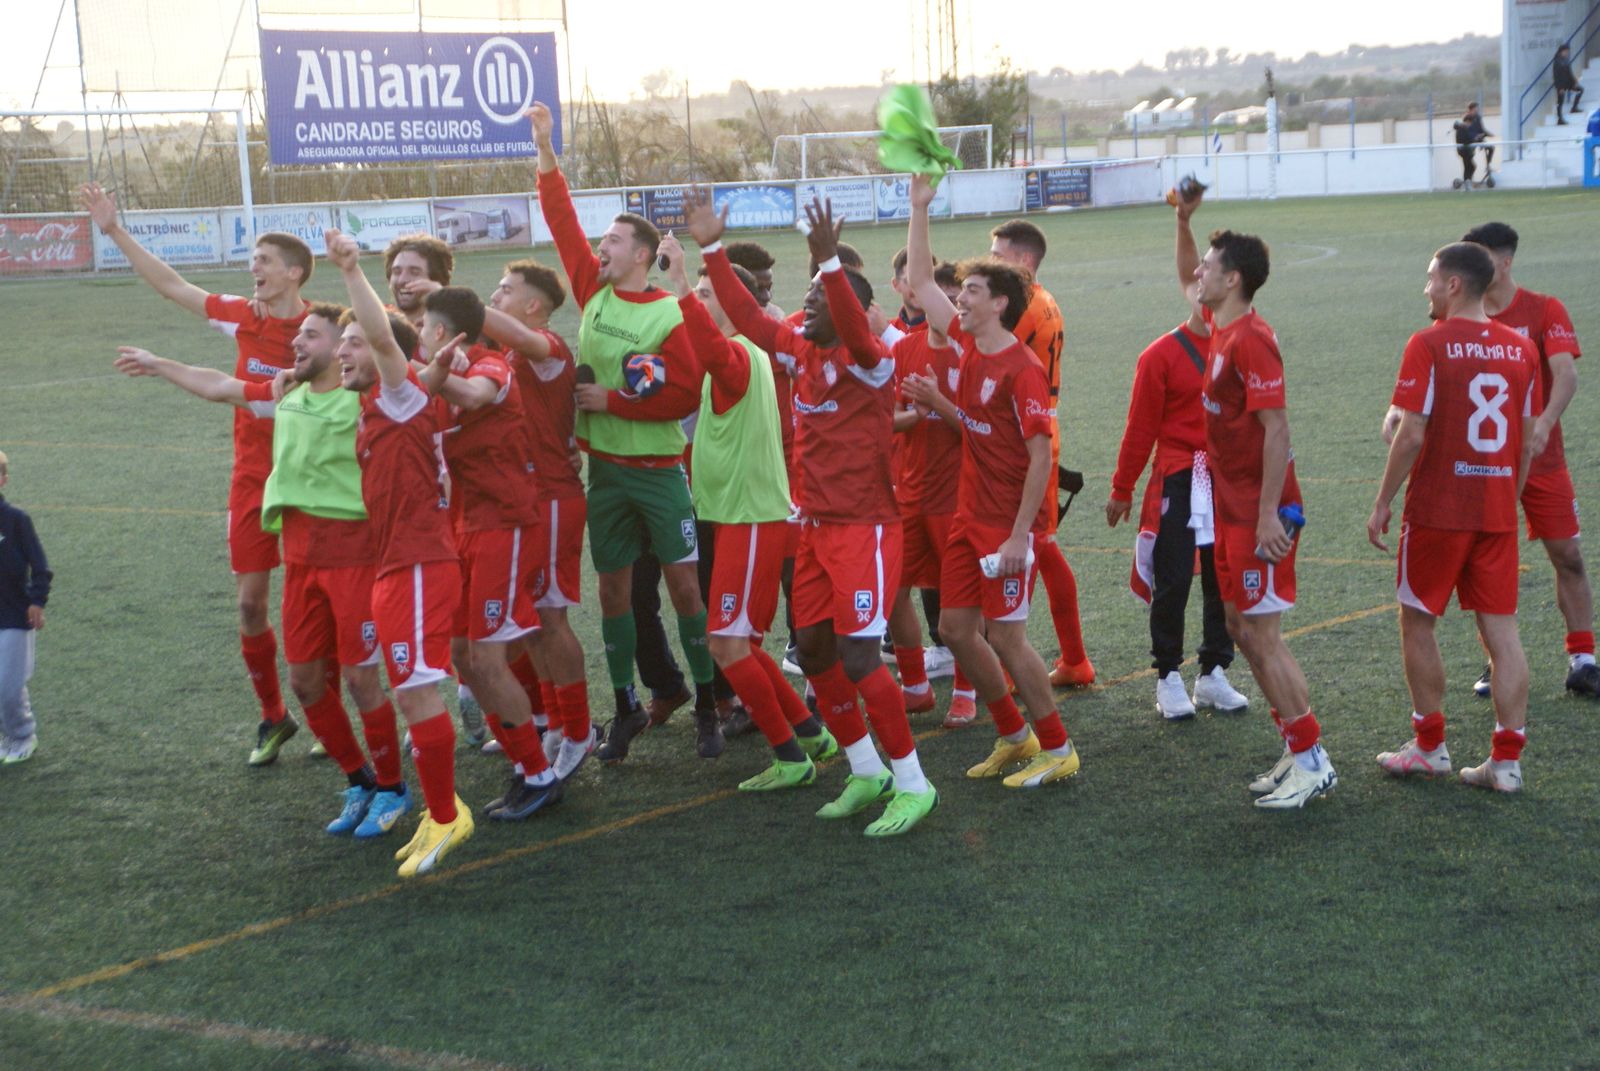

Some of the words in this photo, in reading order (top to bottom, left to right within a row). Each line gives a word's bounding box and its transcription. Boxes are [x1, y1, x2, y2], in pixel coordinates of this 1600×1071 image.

[294, 49, 464, 109] Allianz
[295, 121, 396, 143] CANDRADE
[400, 119, 483, 140] SEGUROS
[297, 146, 365, 158] ASEGURADORA
[366, 145, 400, 156] OFICIAL
[402, 144, 419, 155] DEL
[421, 143, 469, 155] BOLLULLOS
[470, 142, 492, 153] CLUB
[493, 142, 505, 152] DE
[725, 210, 795, 228] UZMAN
[1446, 342, 1463, 359] LA
[1465, 342, 1505, 360] PALMA
[1467, 372, 1509, 453] 8
